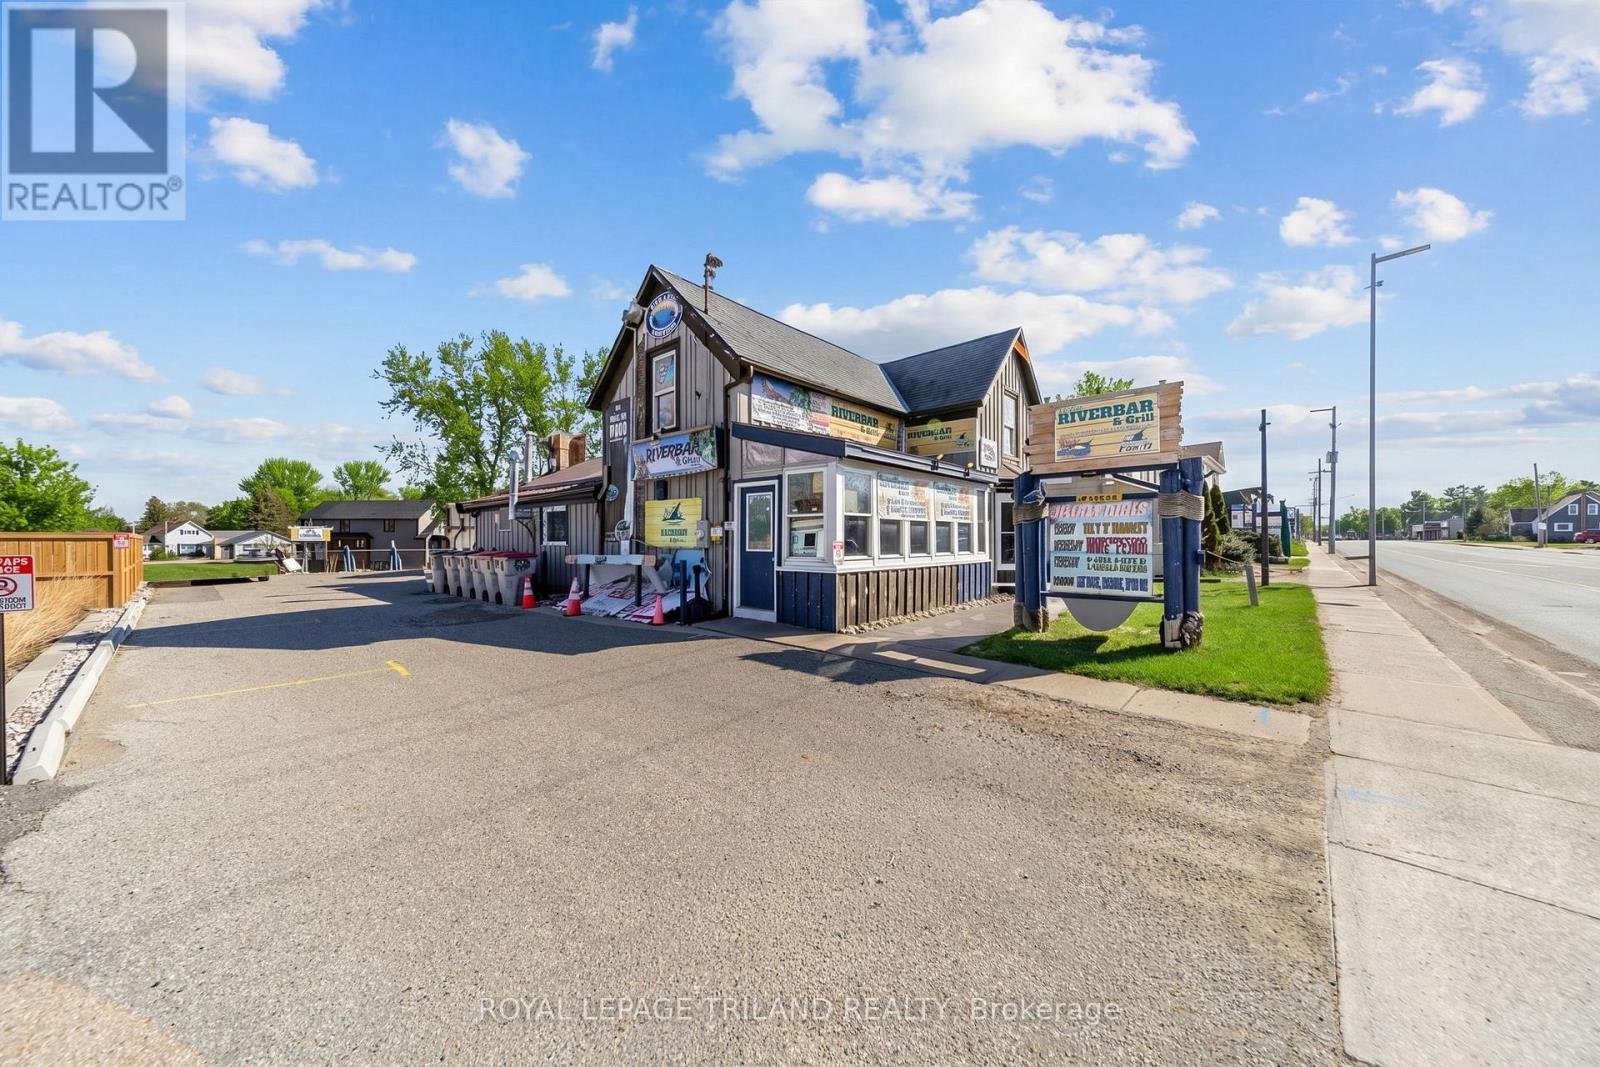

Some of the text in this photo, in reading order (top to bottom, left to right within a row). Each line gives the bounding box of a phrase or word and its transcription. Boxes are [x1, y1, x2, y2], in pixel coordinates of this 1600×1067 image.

[1057, 400, 1154, 425] RIVERBAR
[1125, 412, 1154, 425] Grill
[646, 441, 703, 463] RIVERBAR
